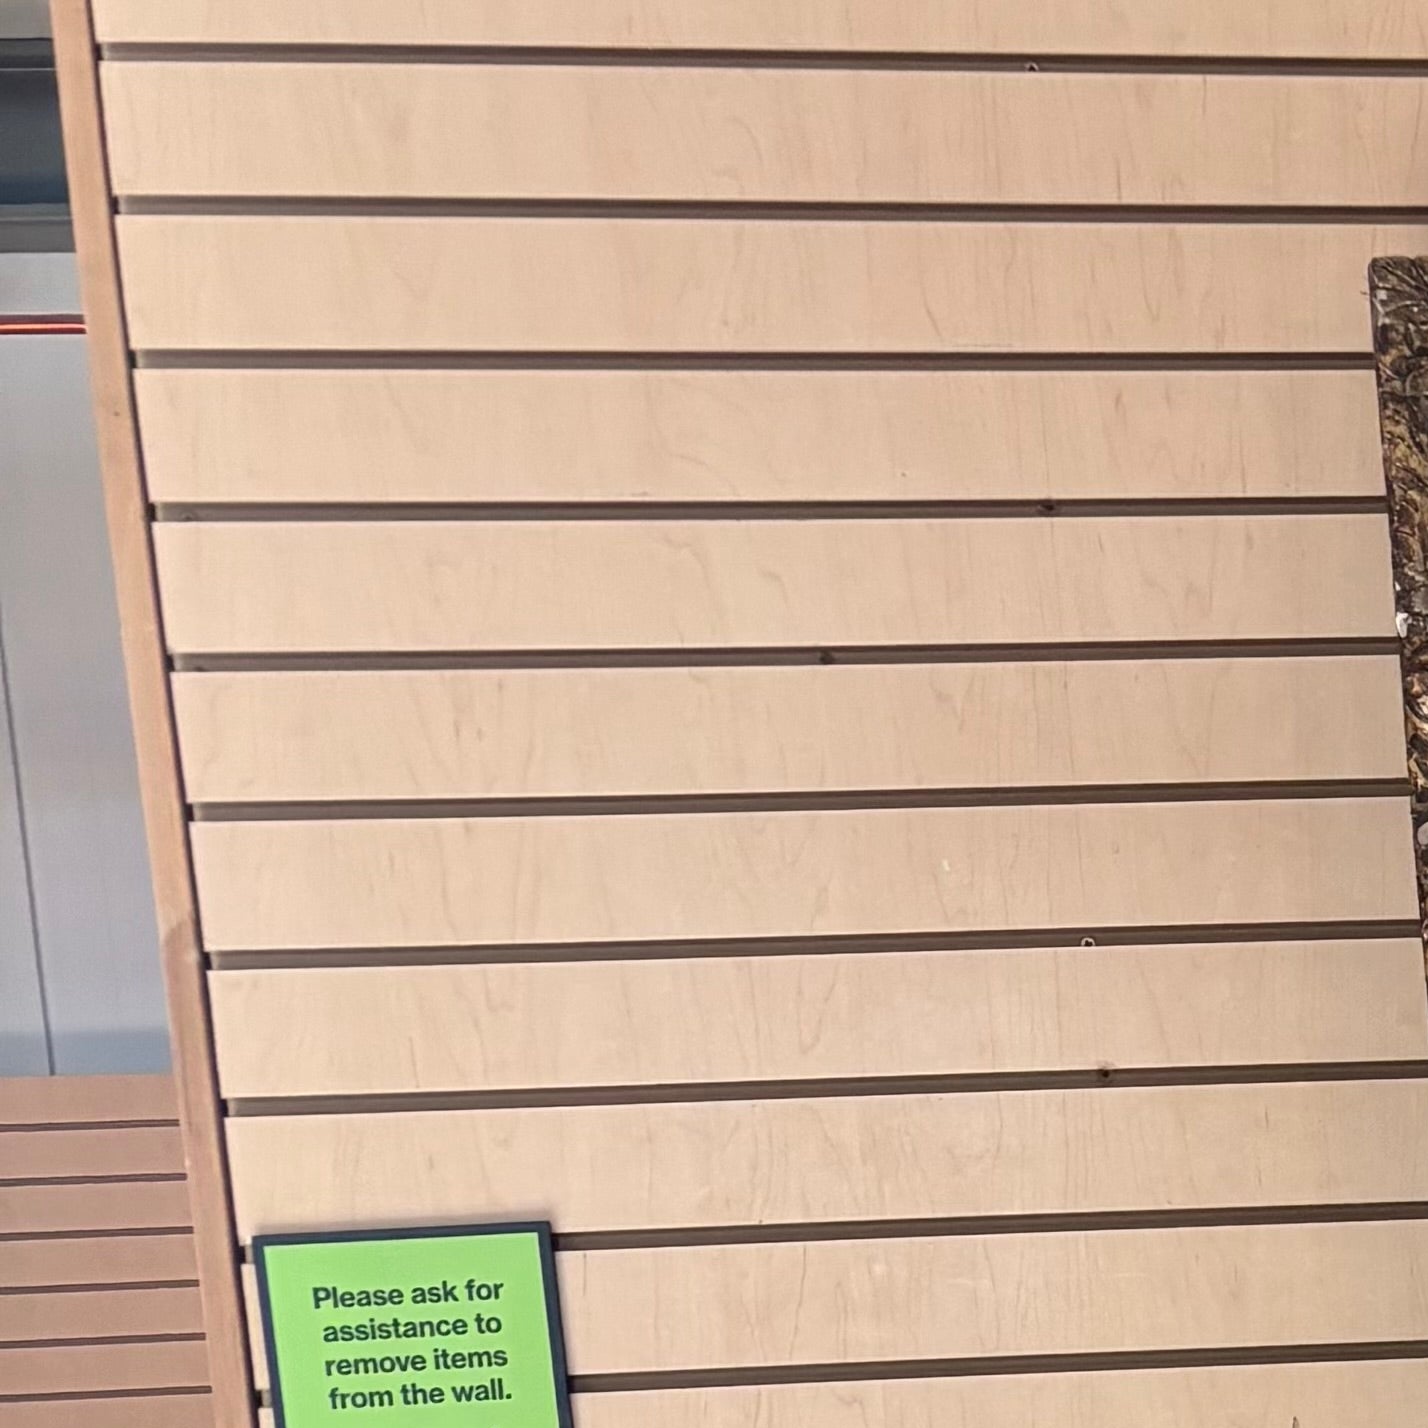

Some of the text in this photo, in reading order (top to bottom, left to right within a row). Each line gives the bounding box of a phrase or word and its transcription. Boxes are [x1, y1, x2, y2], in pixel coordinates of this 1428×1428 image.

[312, 1278, 504, 1309] Please ask for
[323, 1313, 502, 1343] assistance to
[325, 1348, 508, 1377] remove items
[329, 1377, 512, 1410] from the wall.
